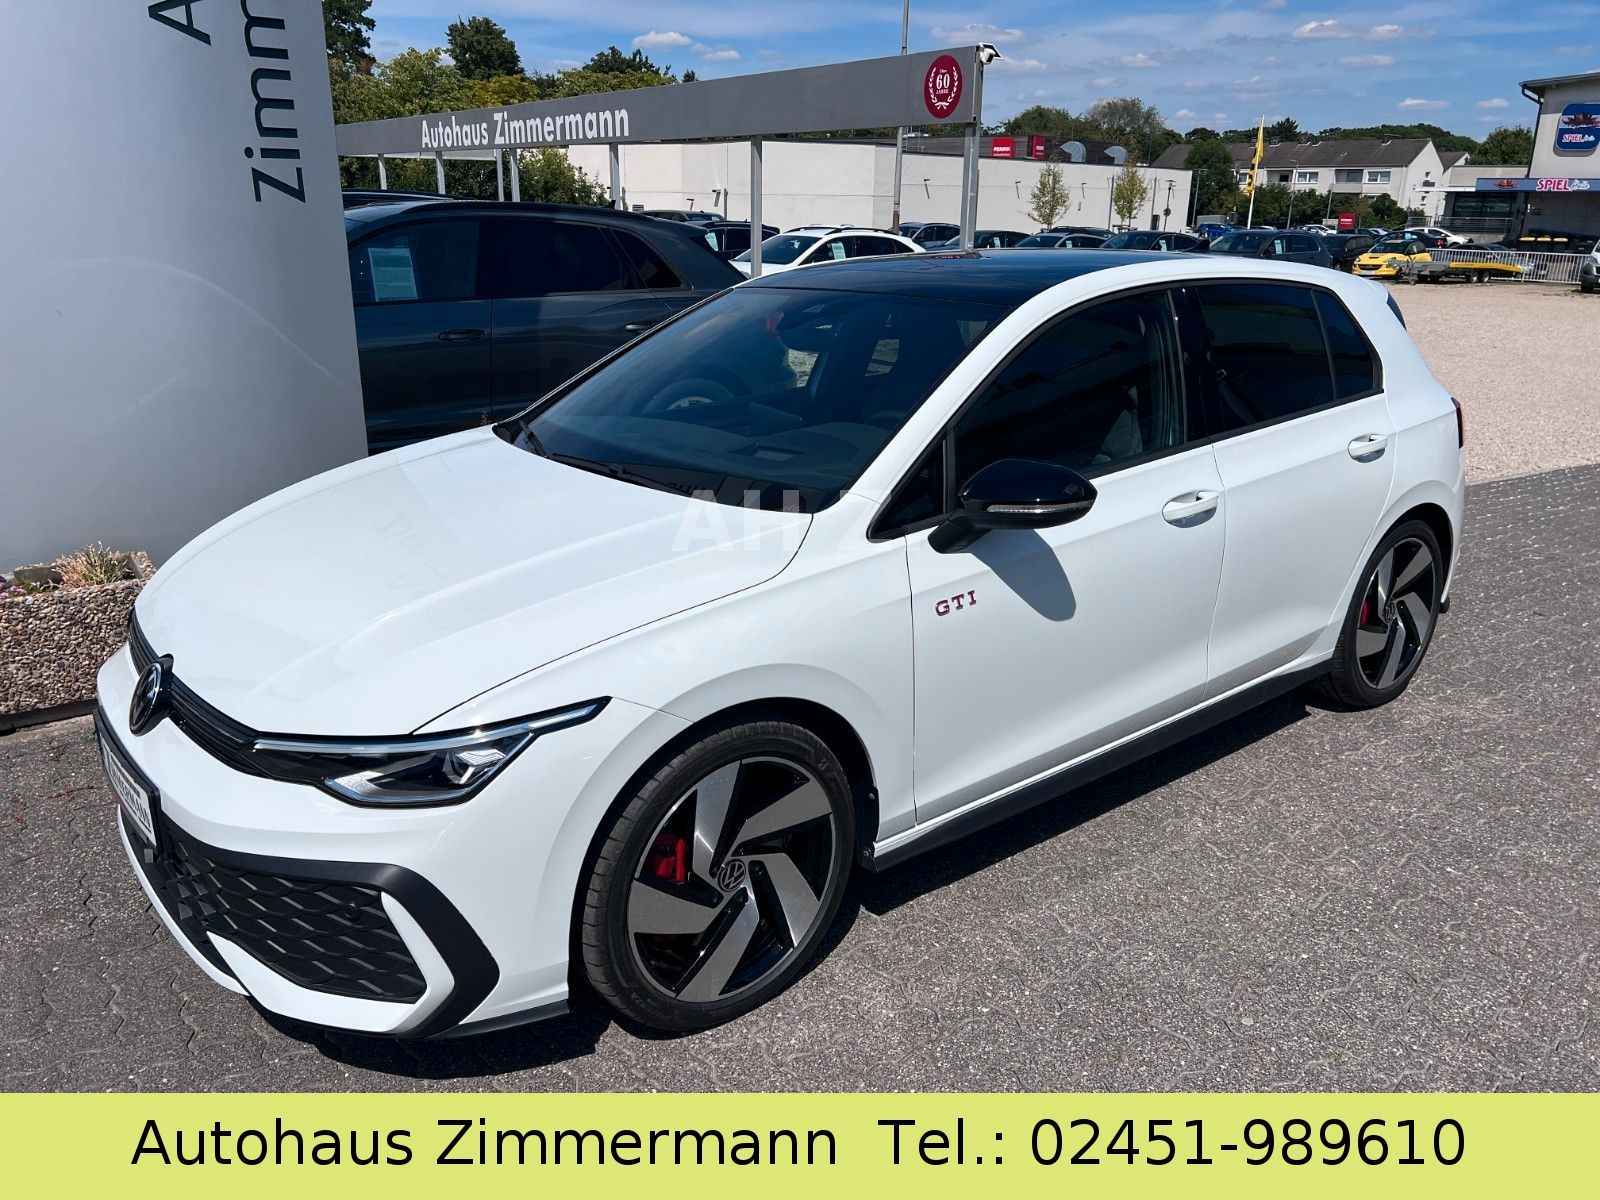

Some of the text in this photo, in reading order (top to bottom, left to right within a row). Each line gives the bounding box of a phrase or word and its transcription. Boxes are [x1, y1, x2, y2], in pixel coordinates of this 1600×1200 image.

[936, 73, 950, 89] 60
[421, 108, 630, 148] Autohaus Zimmermann
[1536, 178, 1571, 192] SPIEL
[934, 589, 977, 617] GTI
